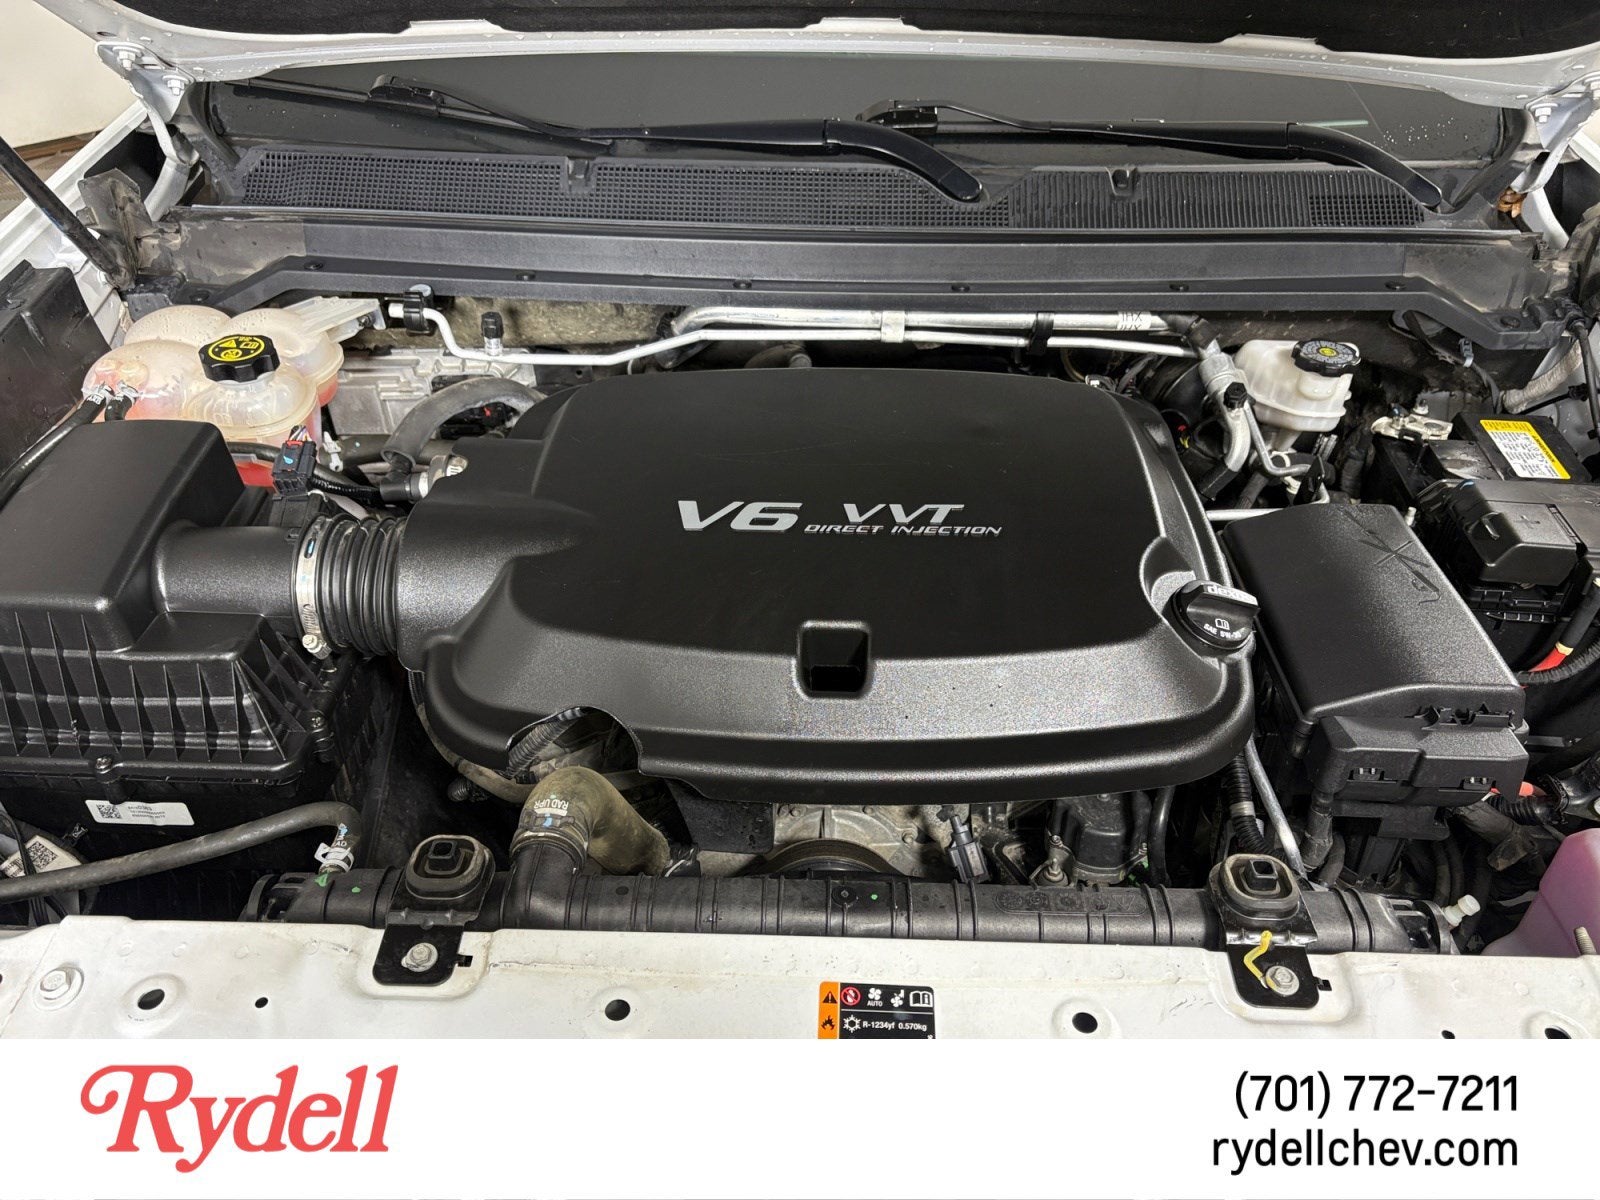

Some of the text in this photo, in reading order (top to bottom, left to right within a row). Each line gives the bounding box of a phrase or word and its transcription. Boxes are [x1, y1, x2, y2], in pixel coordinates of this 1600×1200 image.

[677, 500, 965, 532] V6 VVT
[804, 524, 1002, 536] DIRECT INJECTION
[1203, 623, 1218, 635] SAE
[533, 798, 569, 810] RAD UPR
[862, 1020, 927, 1032] R-1234yf 0.570kg
